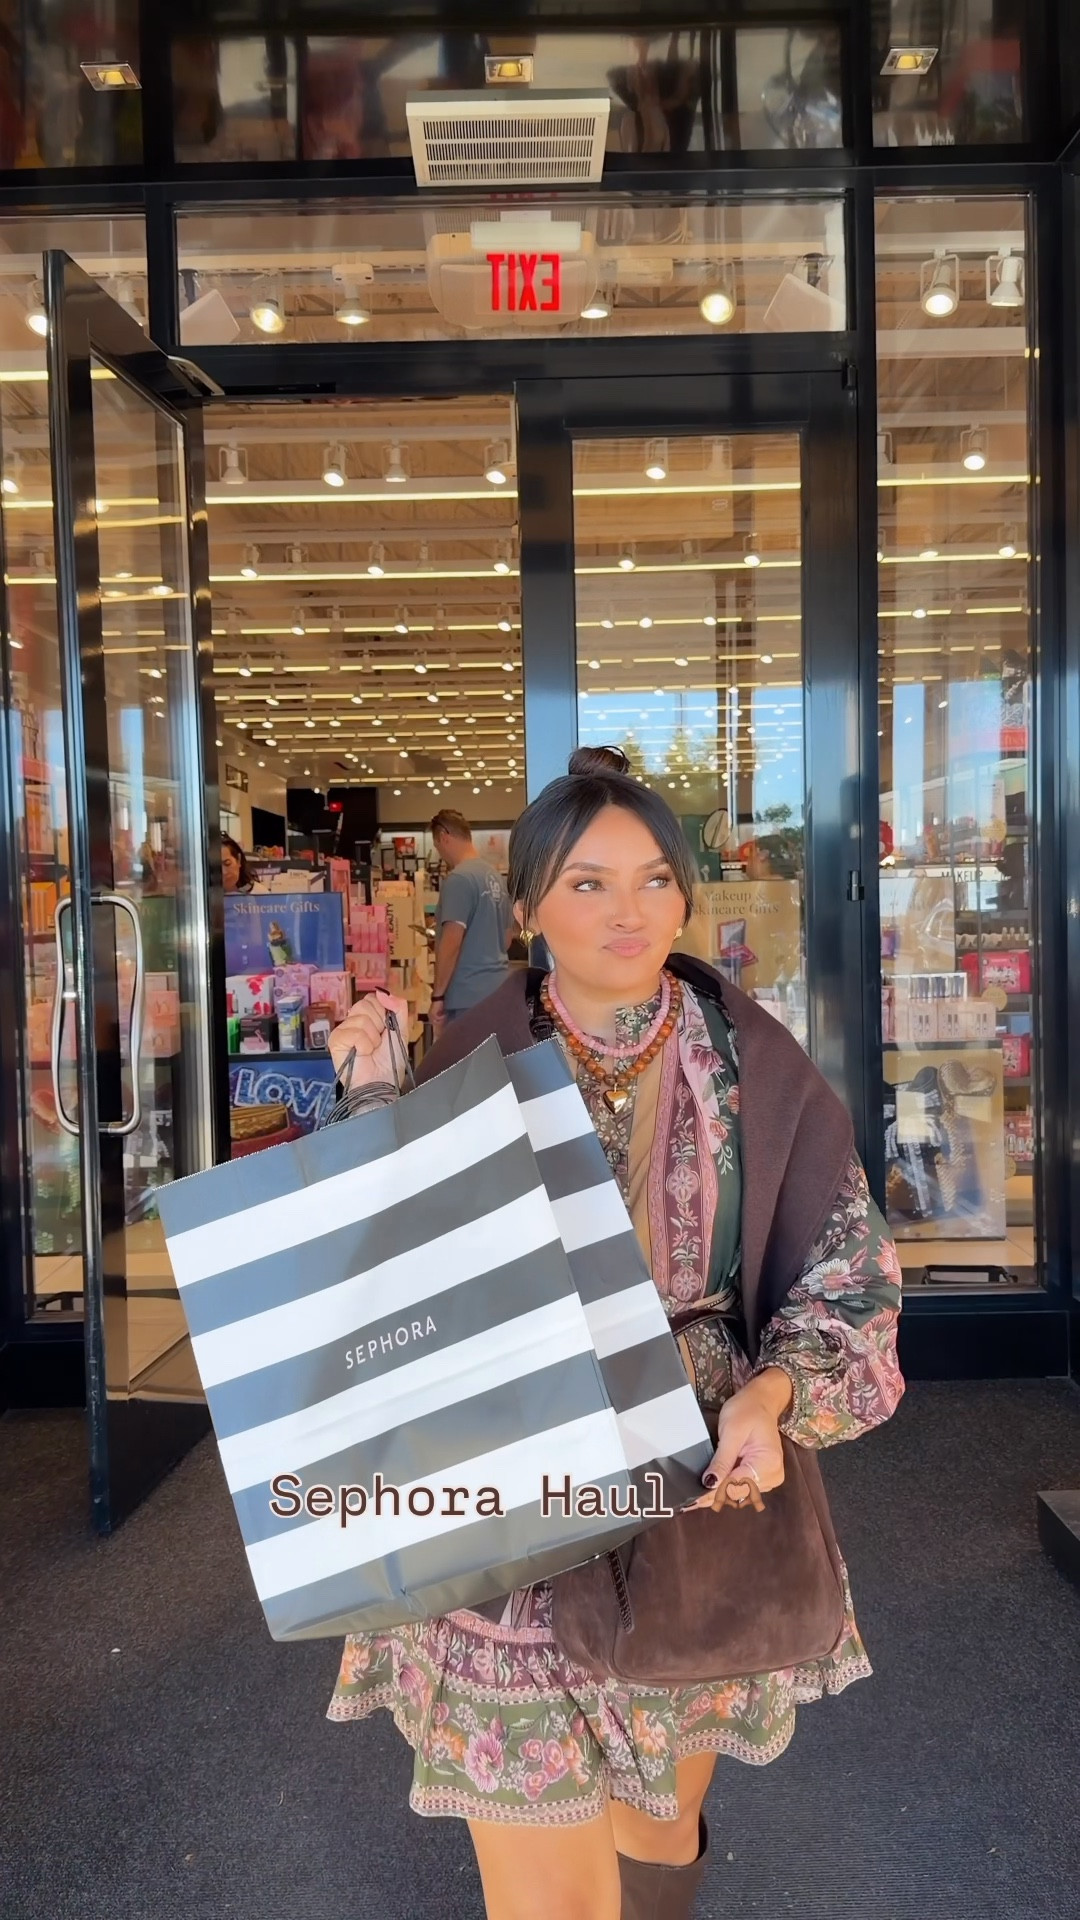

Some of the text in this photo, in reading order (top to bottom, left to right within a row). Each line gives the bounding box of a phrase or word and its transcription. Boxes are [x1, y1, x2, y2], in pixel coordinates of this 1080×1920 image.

[941, 870, 984, 883] MKEUP
[232, 901, 320, 914] Skincare Gifts
[345, 1315, 437, 1370] SEPHORA
